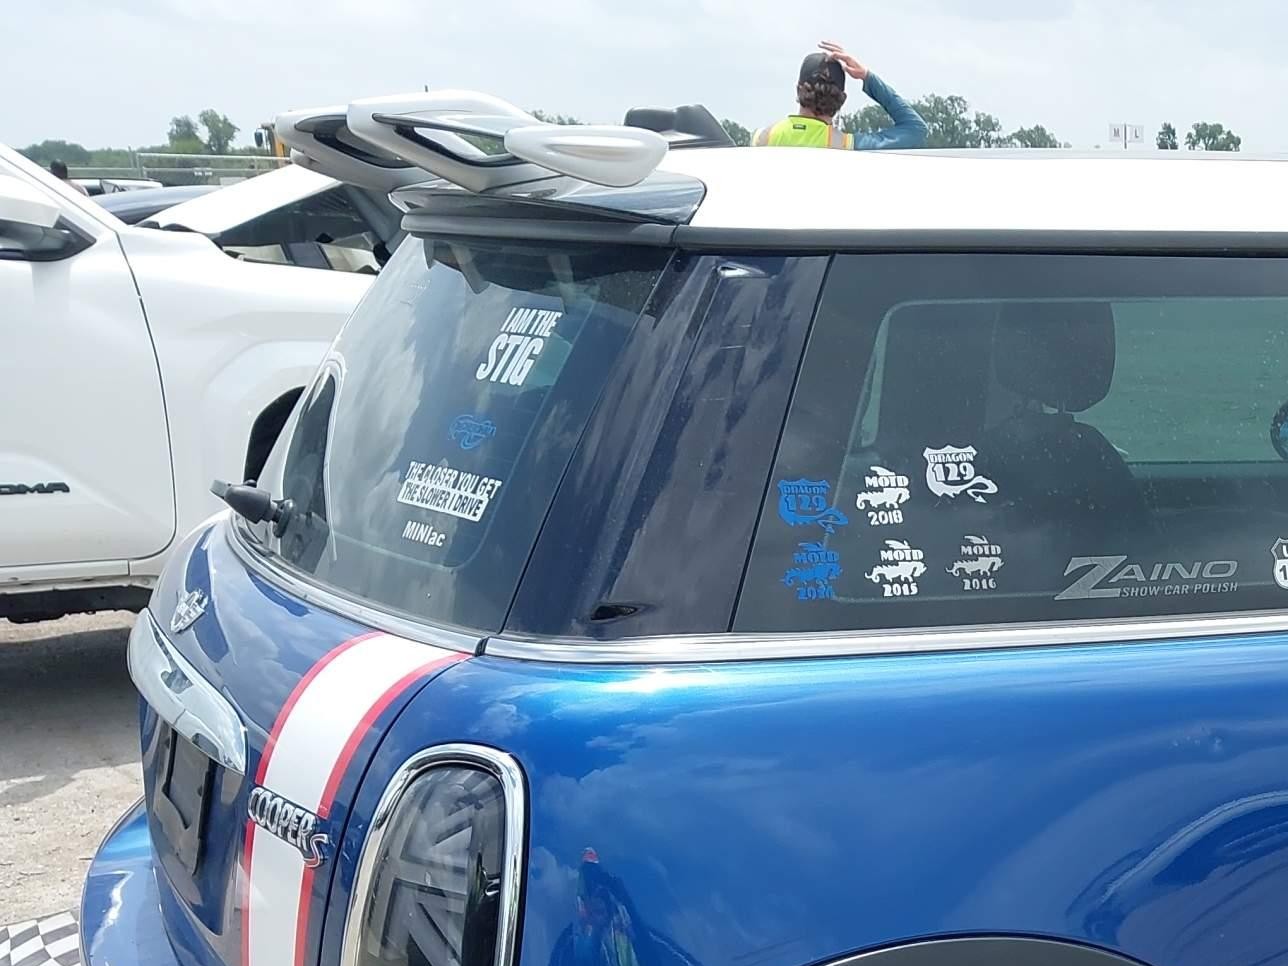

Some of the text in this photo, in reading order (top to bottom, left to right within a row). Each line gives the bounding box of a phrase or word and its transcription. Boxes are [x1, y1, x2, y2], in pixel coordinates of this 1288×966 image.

[505, 308, 538, 334] AM
[528, 309, 563, 337] THE
[476, 333, 544, 386] STIG
[928, 452, 974, 464] DRAGON
[405, 461, 503, 499] THE CLOSER YOU GET
[865, 475, 909, 487] MOTD
[933, 462, 975, 482] 129
[401, 482, 420, 502] THE
[416, 485, 450, 509] SLOWER
[452, 495, 483, 517] DRIVE
[785, 494, 827, 512] 129
[867, 510, 904, 525] 2018
[402, 520, 446, 546] MINIac
[880, 549, 923, 561] MOTD
[961, 545, 1001, 555] MOTD
[963, 578, 997, 591] 2016
[1054, 555, 1238, 601] ZAINO
[883, 583, 918, 597] 2015
[1120, 581, 1238, 598] SHOW CAR POLISH
[248, 787, 329, 868] COOPER S
